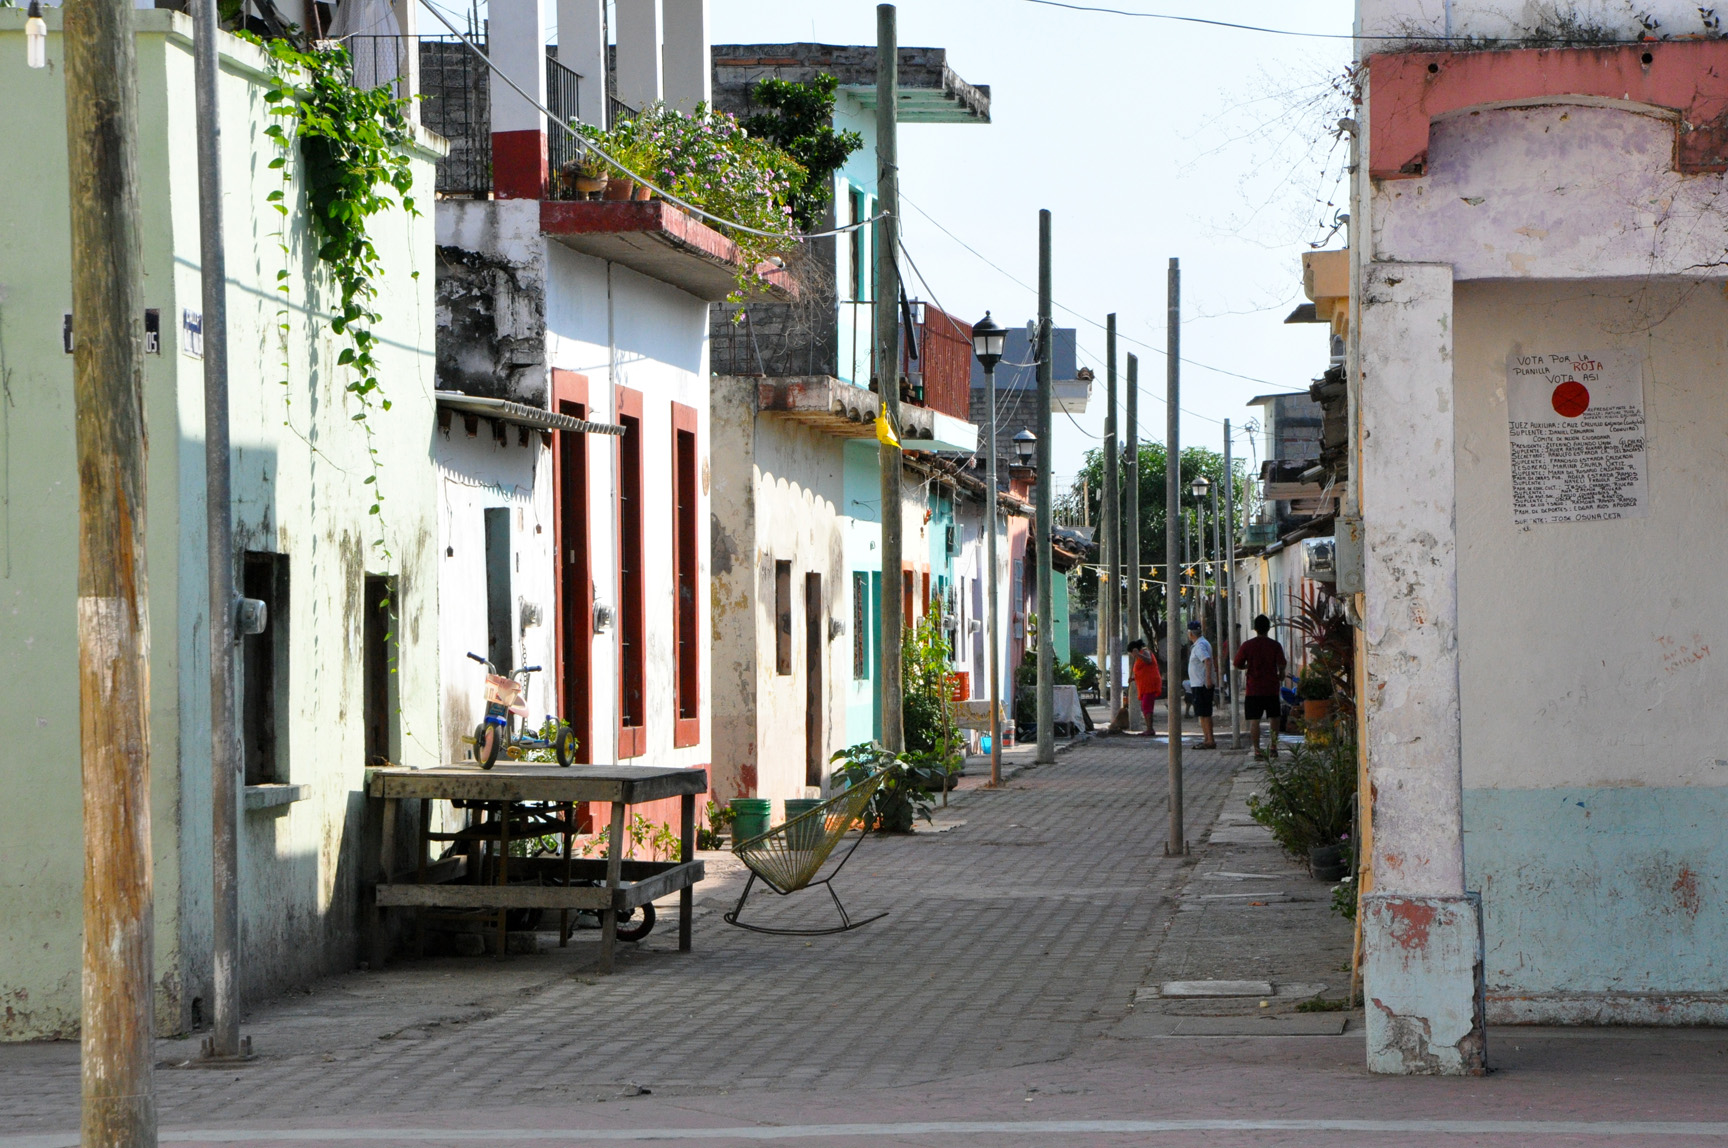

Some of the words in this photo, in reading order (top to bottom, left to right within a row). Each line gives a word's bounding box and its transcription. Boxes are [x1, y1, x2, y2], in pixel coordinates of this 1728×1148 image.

[1517, 356, 1543, 365] VOTA
[1548, 354, 1570, 363] POR
[1512, 367, 1550, 375] PLANILLA
[1569, 361, 1603, 371] ROJA
[1545, 374, 1574, 383] VOTA
[1583, 373, 1599, 381] ASI
[1509, 421, 1528, 429] JUEZ
[1575, 513, 1601, 521] OSUNA
[1603, 512, 1621, 520] CEJA
